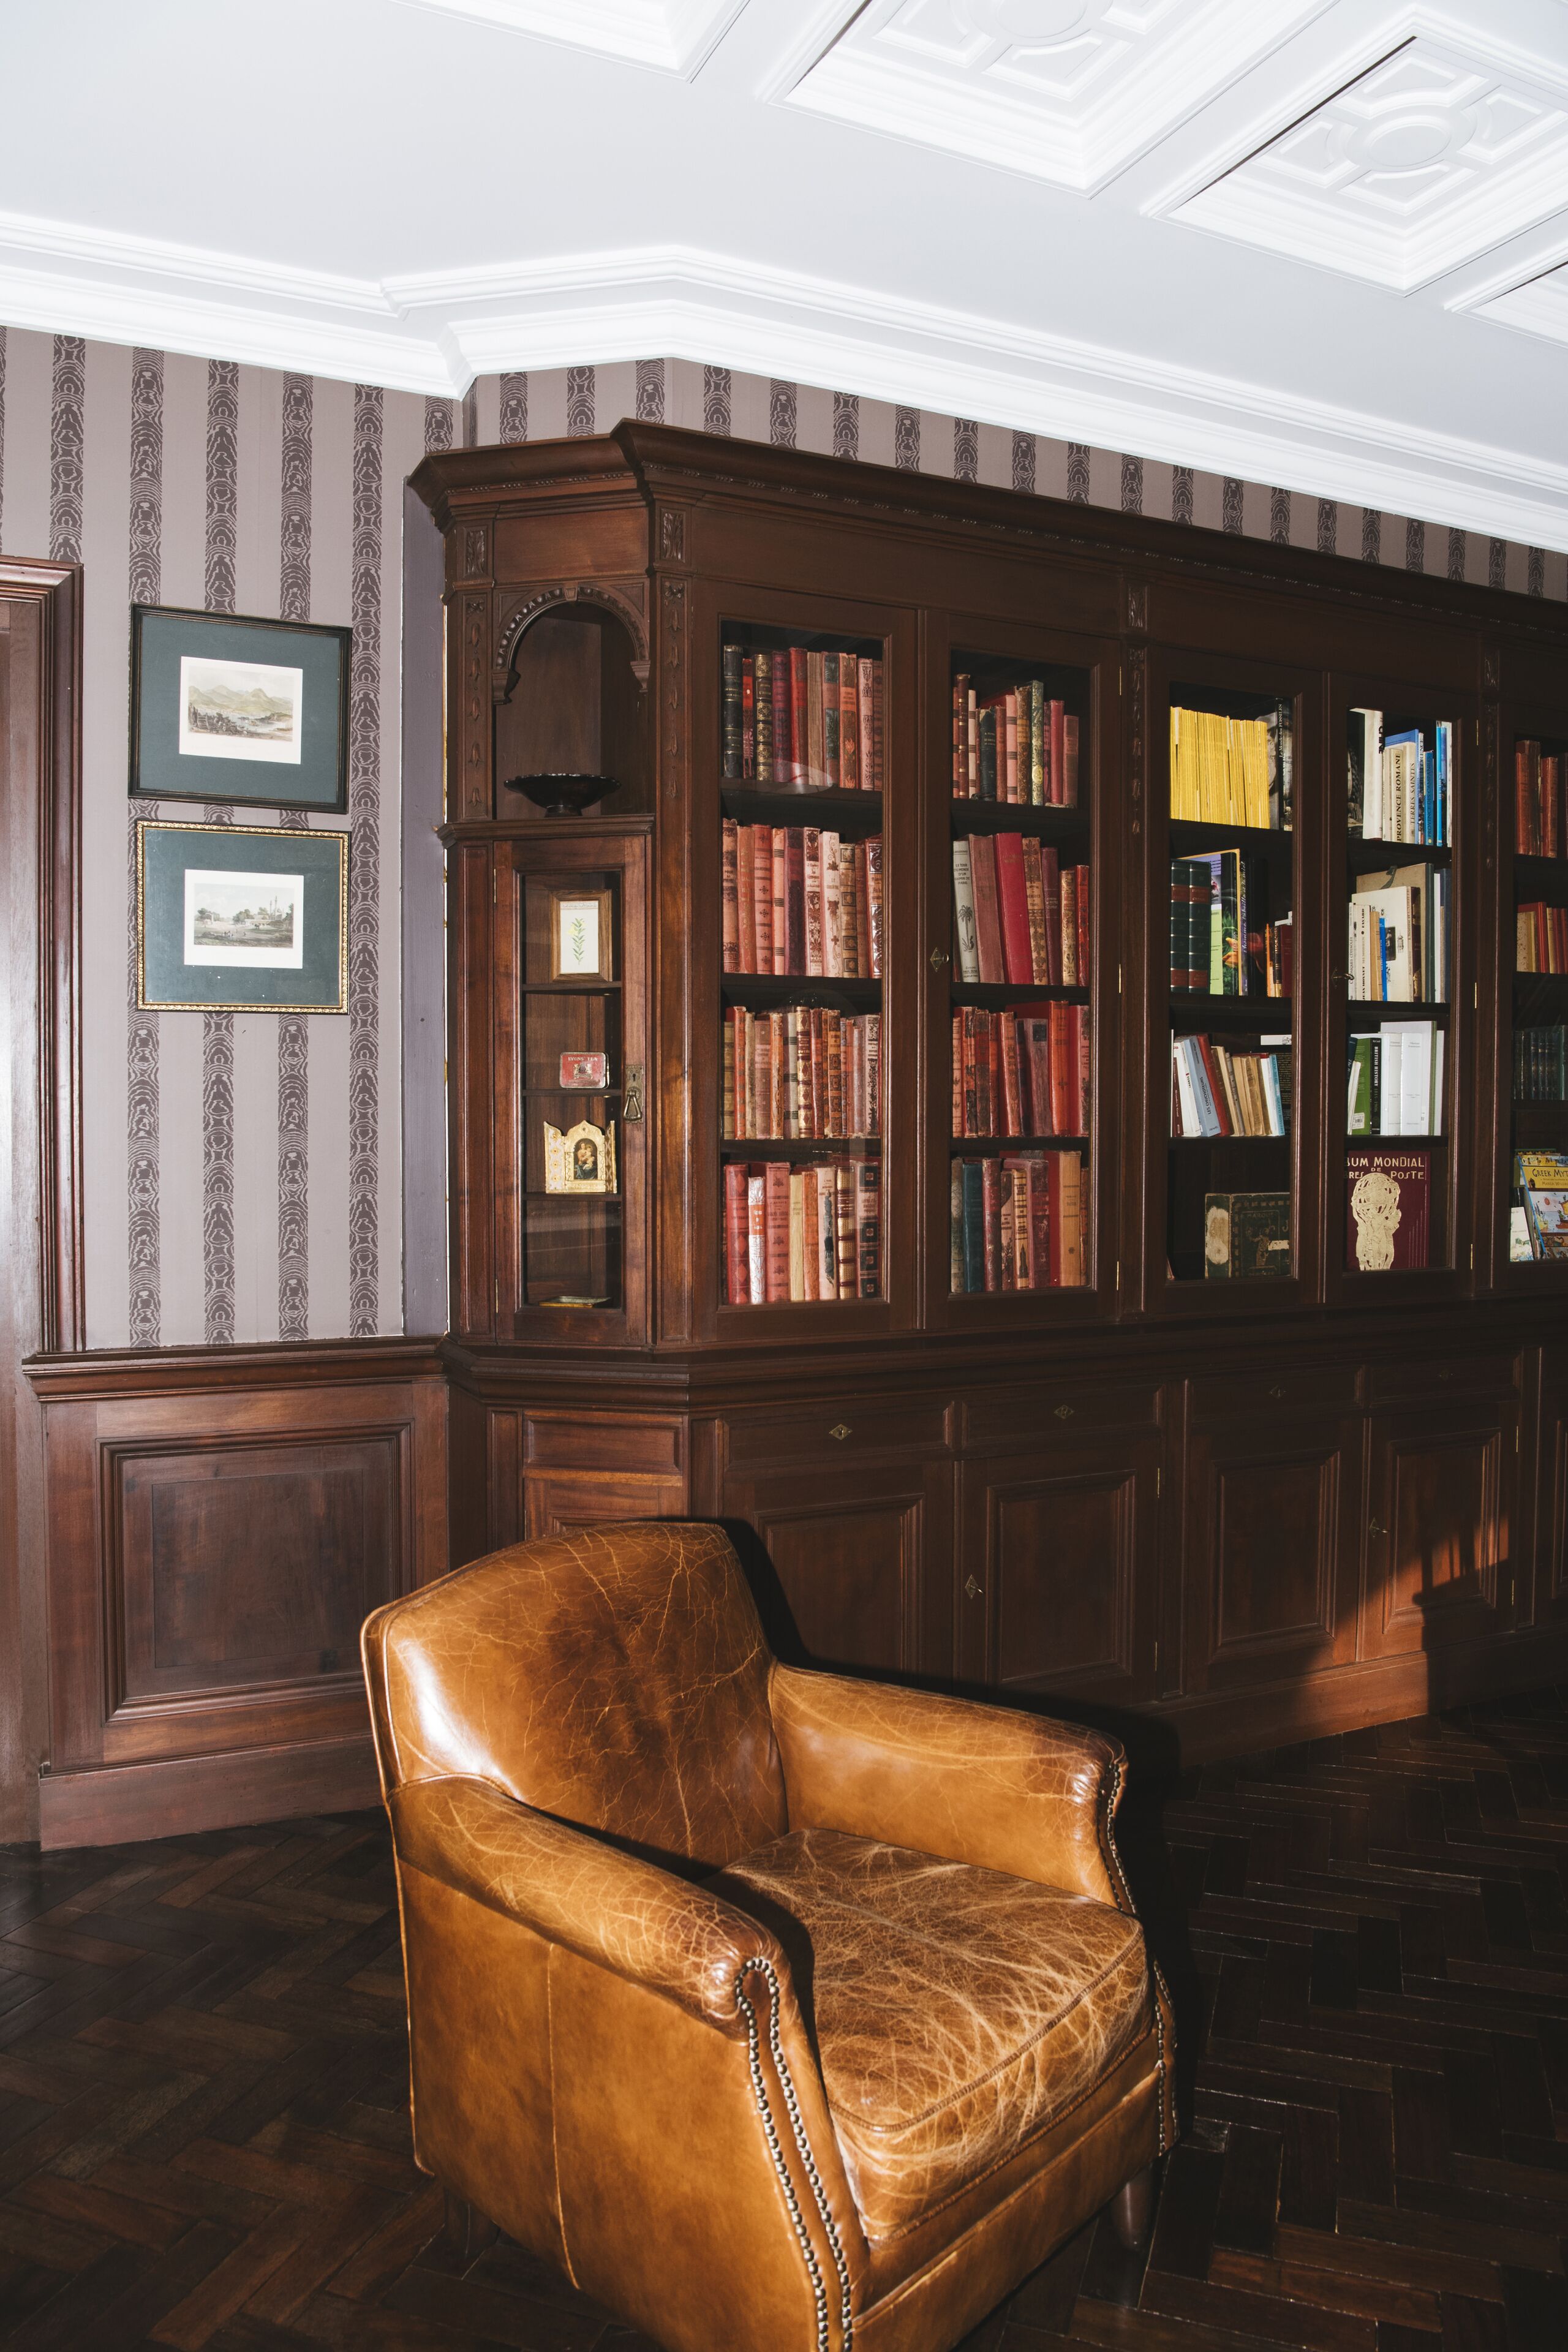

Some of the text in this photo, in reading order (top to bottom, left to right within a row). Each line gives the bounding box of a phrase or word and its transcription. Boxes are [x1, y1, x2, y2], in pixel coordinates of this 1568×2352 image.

[1199, 1076, 1210, 1106] CHUCHOTEURS
[1373, 1156, 1425, 1167] MONDIAL
[1532, 1168, 1551, 1177] GREEK
